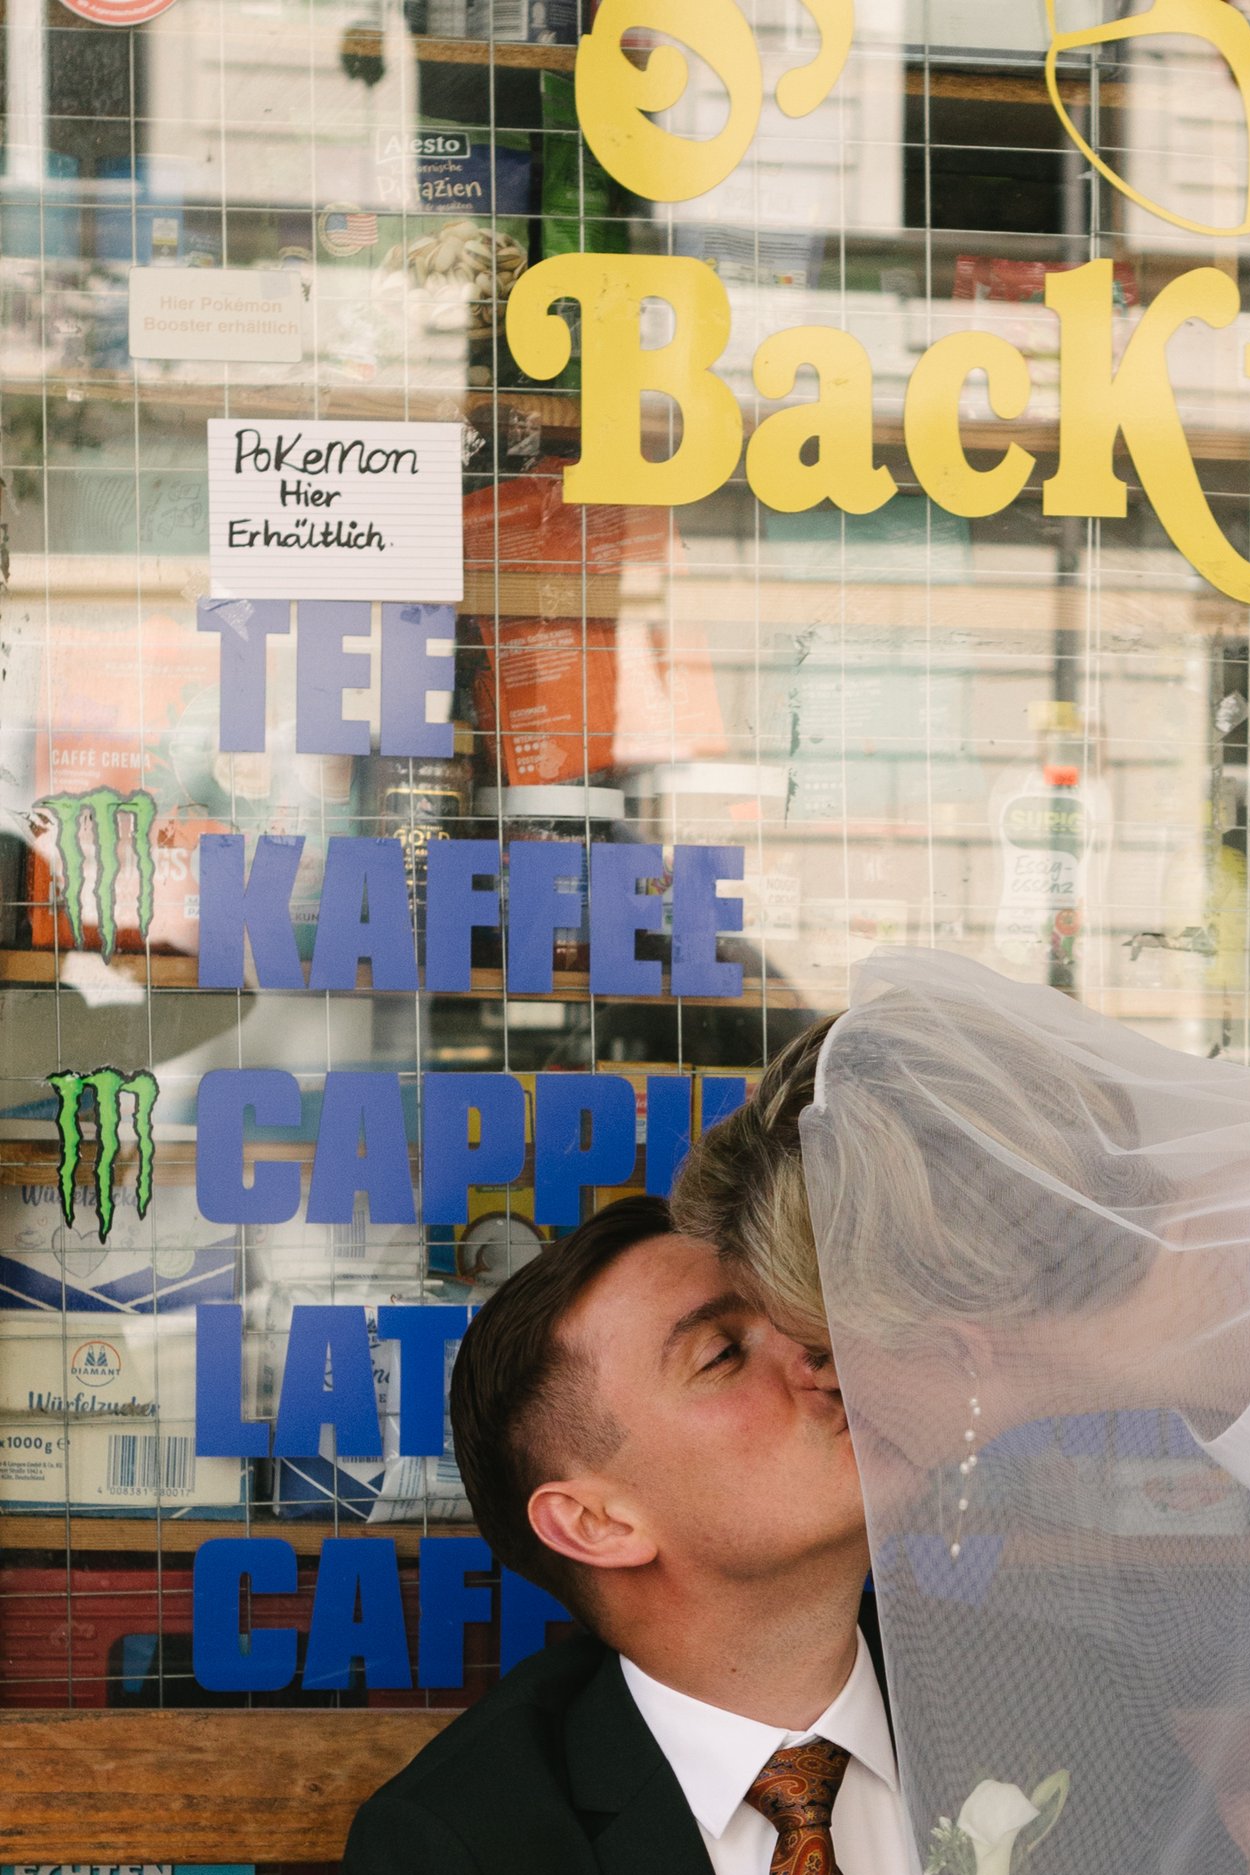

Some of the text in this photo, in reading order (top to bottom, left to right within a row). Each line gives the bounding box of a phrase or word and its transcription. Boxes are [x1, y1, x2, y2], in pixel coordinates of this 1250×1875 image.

[143, 316, 213, 333] Booster
[279, 478, 342, 507] Hier
[197, 601, 456, 758] TEE
[199, 833, 745, 997] KAFFEE
[71, 1367, 121, 1376] DIAMANT
[28, 1390, 160, 1418] Würfelzucker
